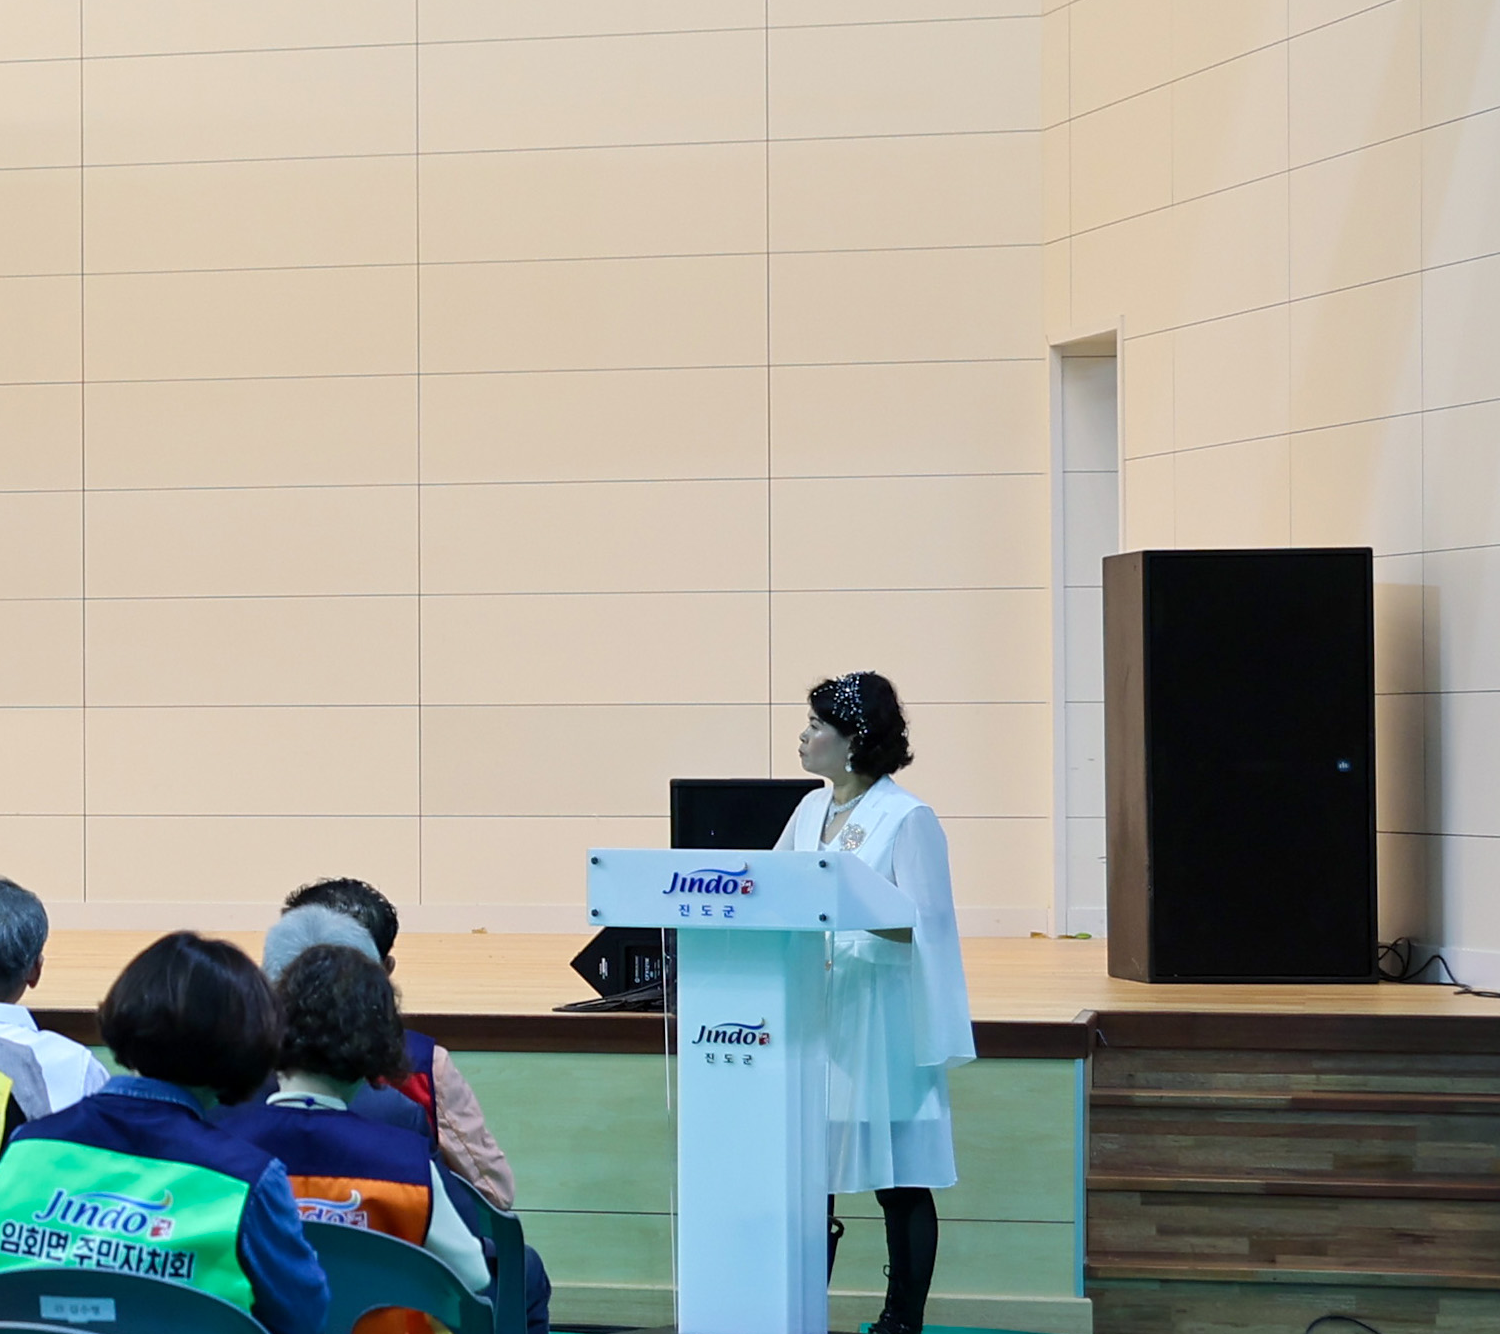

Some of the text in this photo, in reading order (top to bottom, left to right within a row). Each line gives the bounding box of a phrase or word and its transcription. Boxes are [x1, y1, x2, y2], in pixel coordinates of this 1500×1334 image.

[663, 871, 739, 895] Jindo
[692, 1024, 758, 1046] Jindo
[34, 1189, 149, 1235] Jindo
[71, 1234, 197, 1281] 주민자치회
